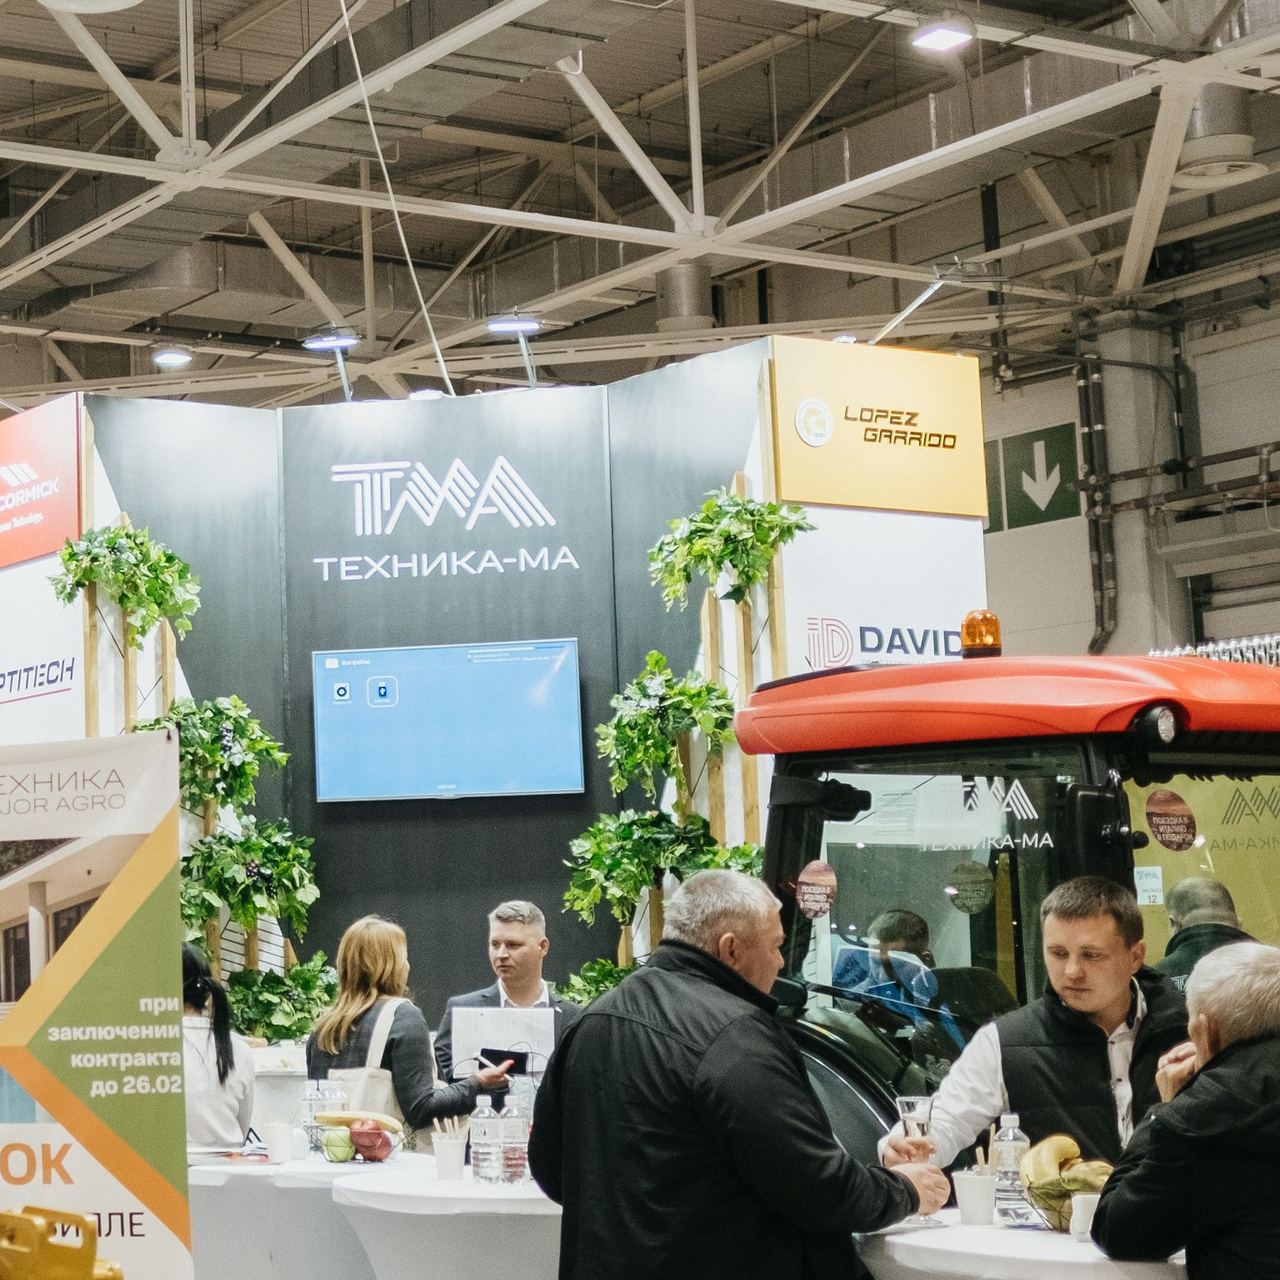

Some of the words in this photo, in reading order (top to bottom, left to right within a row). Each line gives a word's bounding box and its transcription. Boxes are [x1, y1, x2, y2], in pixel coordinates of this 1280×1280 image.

[844, 405, 920, 427] LOPEZ
[863, 427, 958, 449] GARRIDO
[312, 545, 581, 582] ТЕХНИКА-МА
[859, 626, 962, 657] DAVID
[55, 792, 127, 813] AGRO
[1152, 816, 1183, 824] ПОЕЗДКА
[1158, 825, 1187, 833] ИТАЛИЮ
[1162, 833, 1194, 842] ПОДАРОК
[139, 996, 180, 1017] при
[47, 1022, 182, 1044] заключении
[70, 1050, 183, 1072] контракта
[90, 1079, 119, 1098] до
[122, 1075, 183, 1096] 26.02
